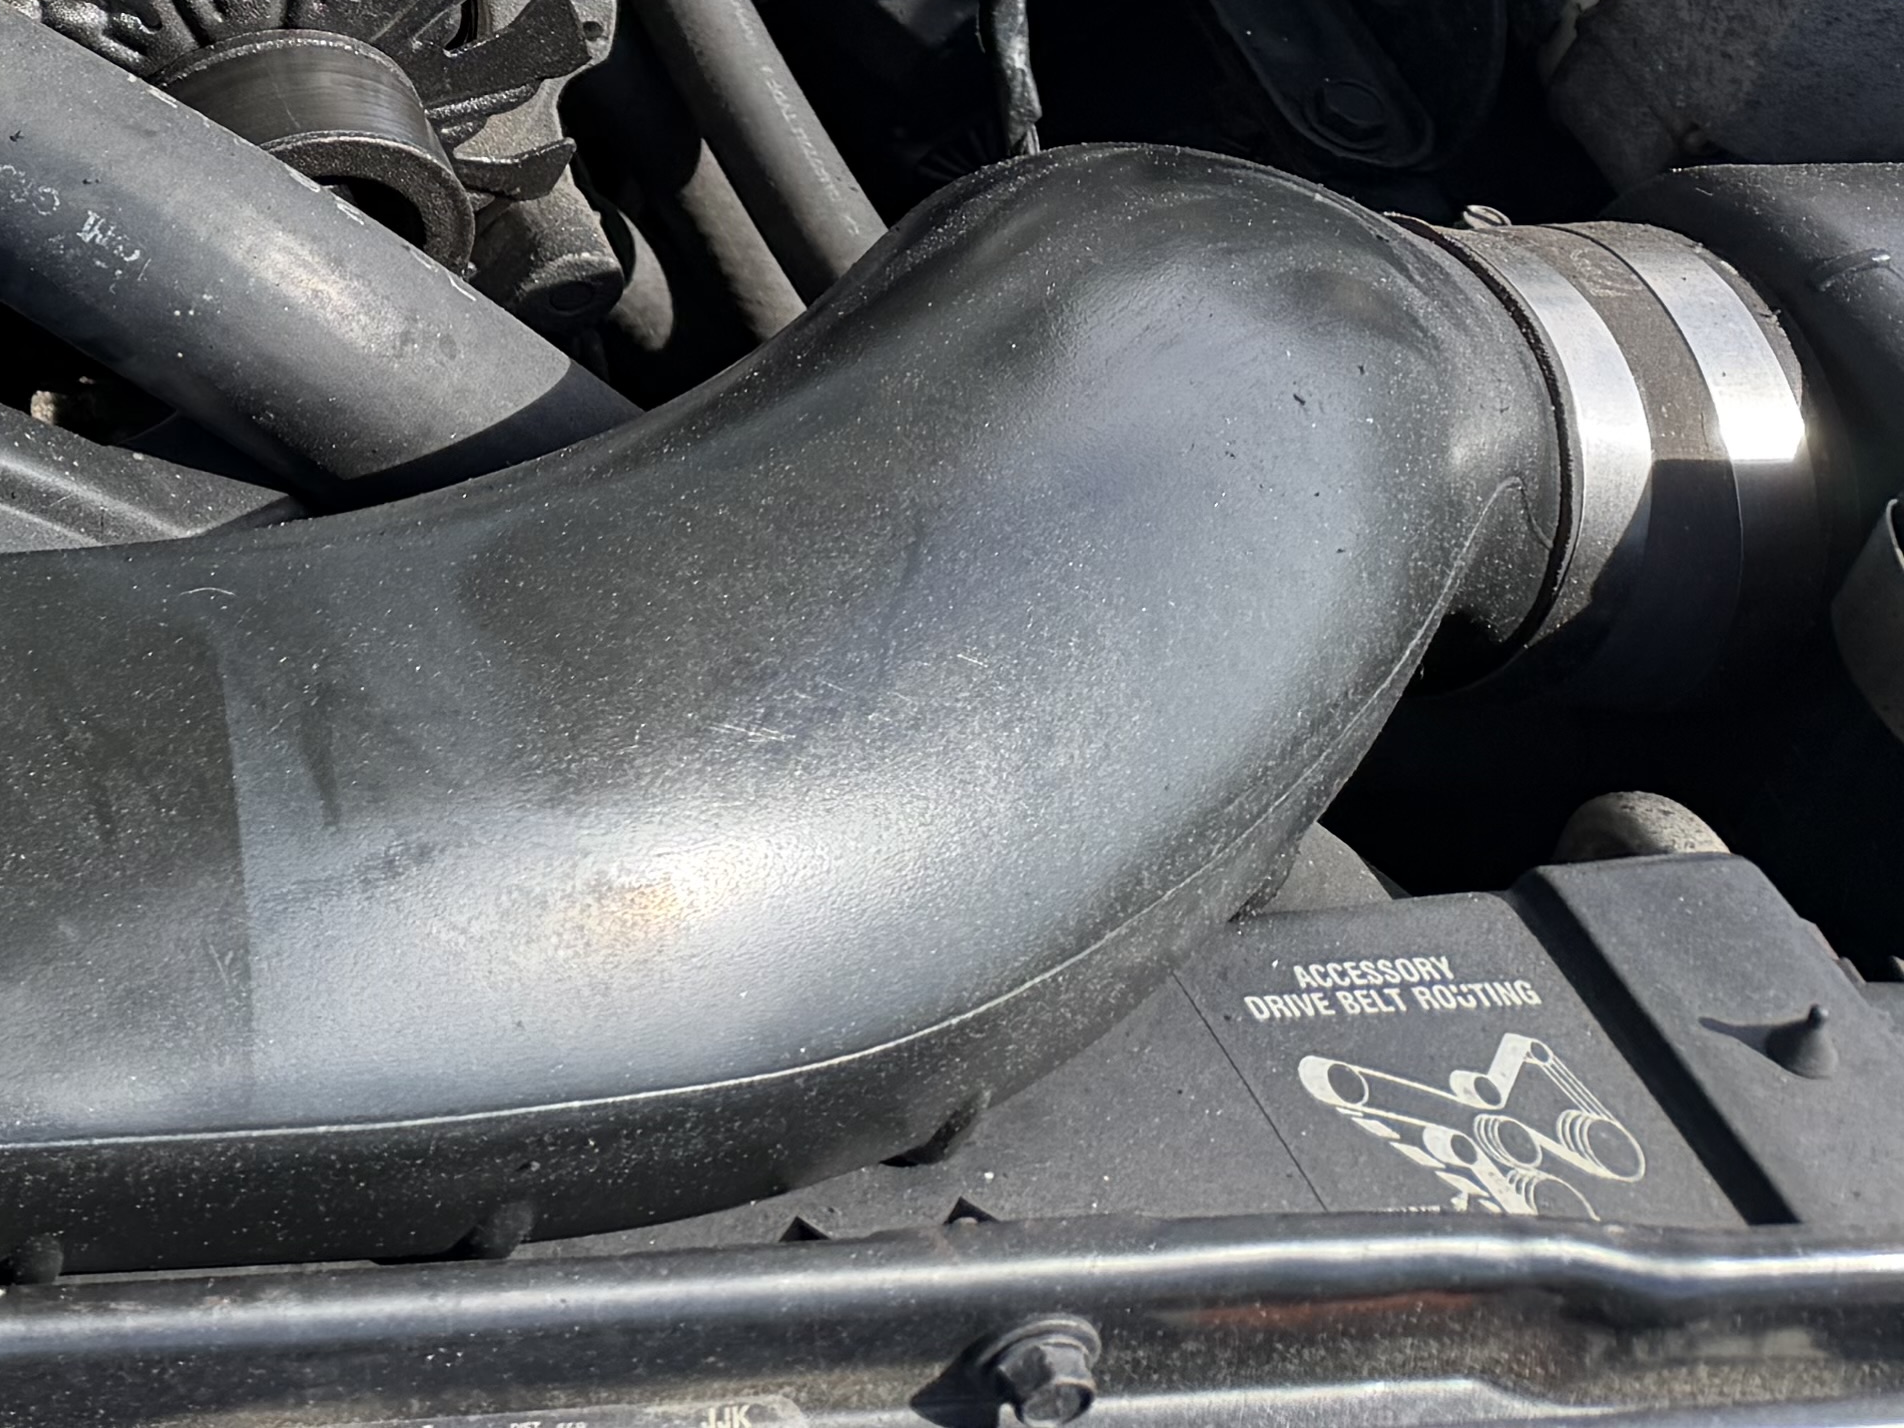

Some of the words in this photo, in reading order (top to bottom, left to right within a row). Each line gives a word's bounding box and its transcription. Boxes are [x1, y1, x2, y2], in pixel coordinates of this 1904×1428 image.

[1294, 955, 1454, 990] ACCESSORY
[1244, 989, 1337, 1021] DRIVE
[1338, 986, 1408, 1015] BELT
[1417, 979, 1543, 1012] ROUTING
